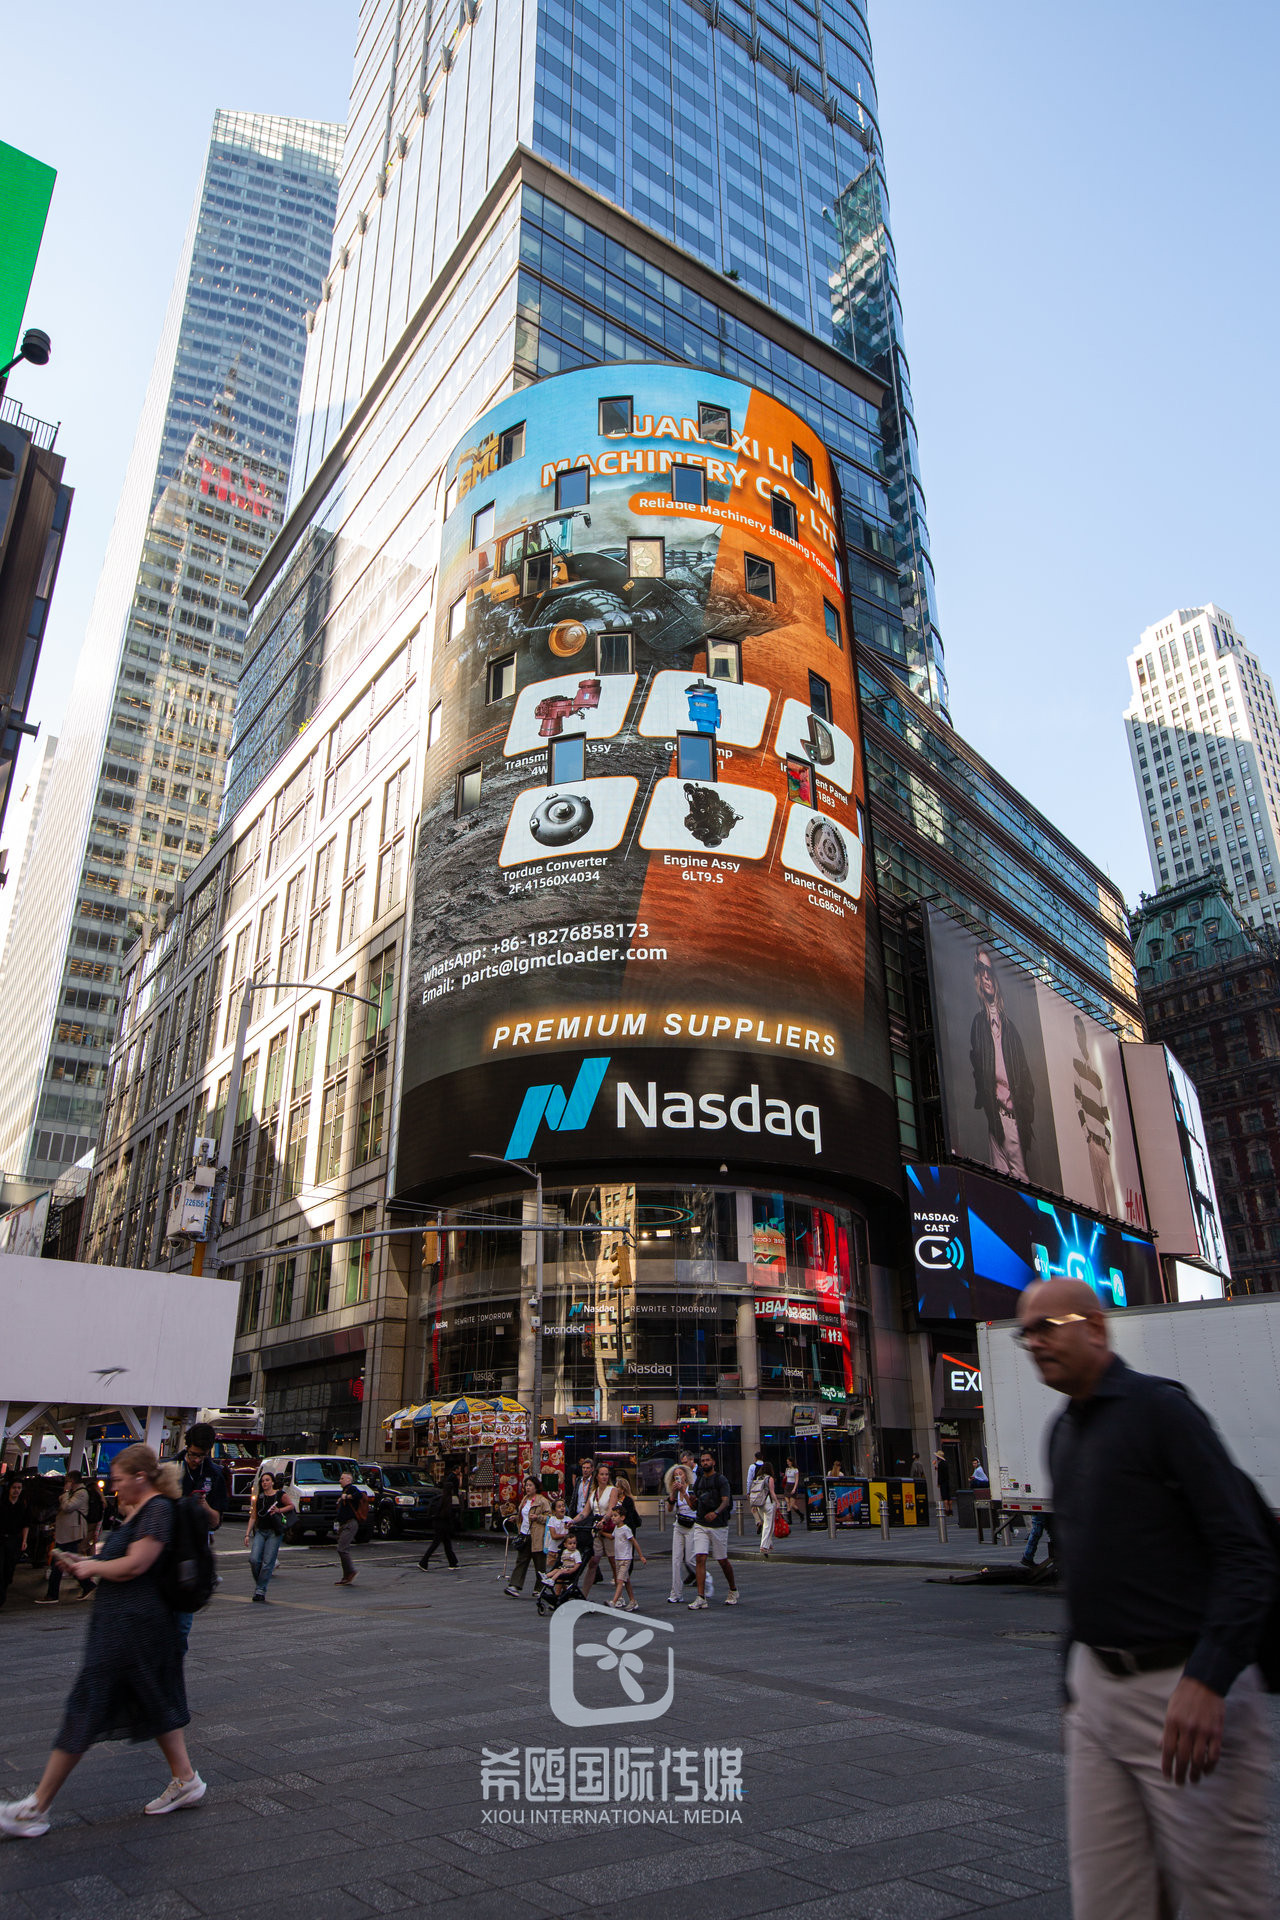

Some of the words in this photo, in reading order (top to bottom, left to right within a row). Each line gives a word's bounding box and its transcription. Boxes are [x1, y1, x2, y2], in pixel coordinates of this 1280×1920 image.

[605, 415, 759, 461] UANXI
[542, 451, 748, 488] MACHINERY
[639, 498, 696, 513] Reliable
[700, 504, 767, 533] Machinery
[769, 525, 811, 560] Building
[829, 784, 849, 806] Panel
[503, 865, 544, 883] Tordue
[546, 856, 608, 873] Converter
[663, 855, 708, 869] Engine
[711, 858, 740, 873] Assy
[508, 871, 600, 895] 2F.41560X4034
[784, 872, 816, 892] Planet
[817, 884, 842, 903] Carier
[842, 895, 858, 914] Assy
[808, 894, 845, 918] CLG862H
[422, 947, 487, 984] whatsApp:
[491, 922, 649, 956] +86-18276858173
[422, 980, 455, 1005] Email:
[461, 945, 668, 990] parts@lgmcloader.com
[493, 1013, 647, 1050] PREMIUM
[663, 1013, 836, 1056] SUPPLIERS
[616, 1081, 823, 1155] Nasdaq
[913, 1212, 959, 1224] NASDAQ:
[924, 1223, 950, 1233] CAST
[477, 1311, 513, 1322] TOMORROW
[583, 1304, 615, 1315] Nasdaq
[630, 1305, 667, 1313] REWRITE
[670, 1305, 718, 1314] TOMORROW
[627, 1363, 673, 1377] Nasdaq
[784, 1367, 804, 1379] Nasdaq
